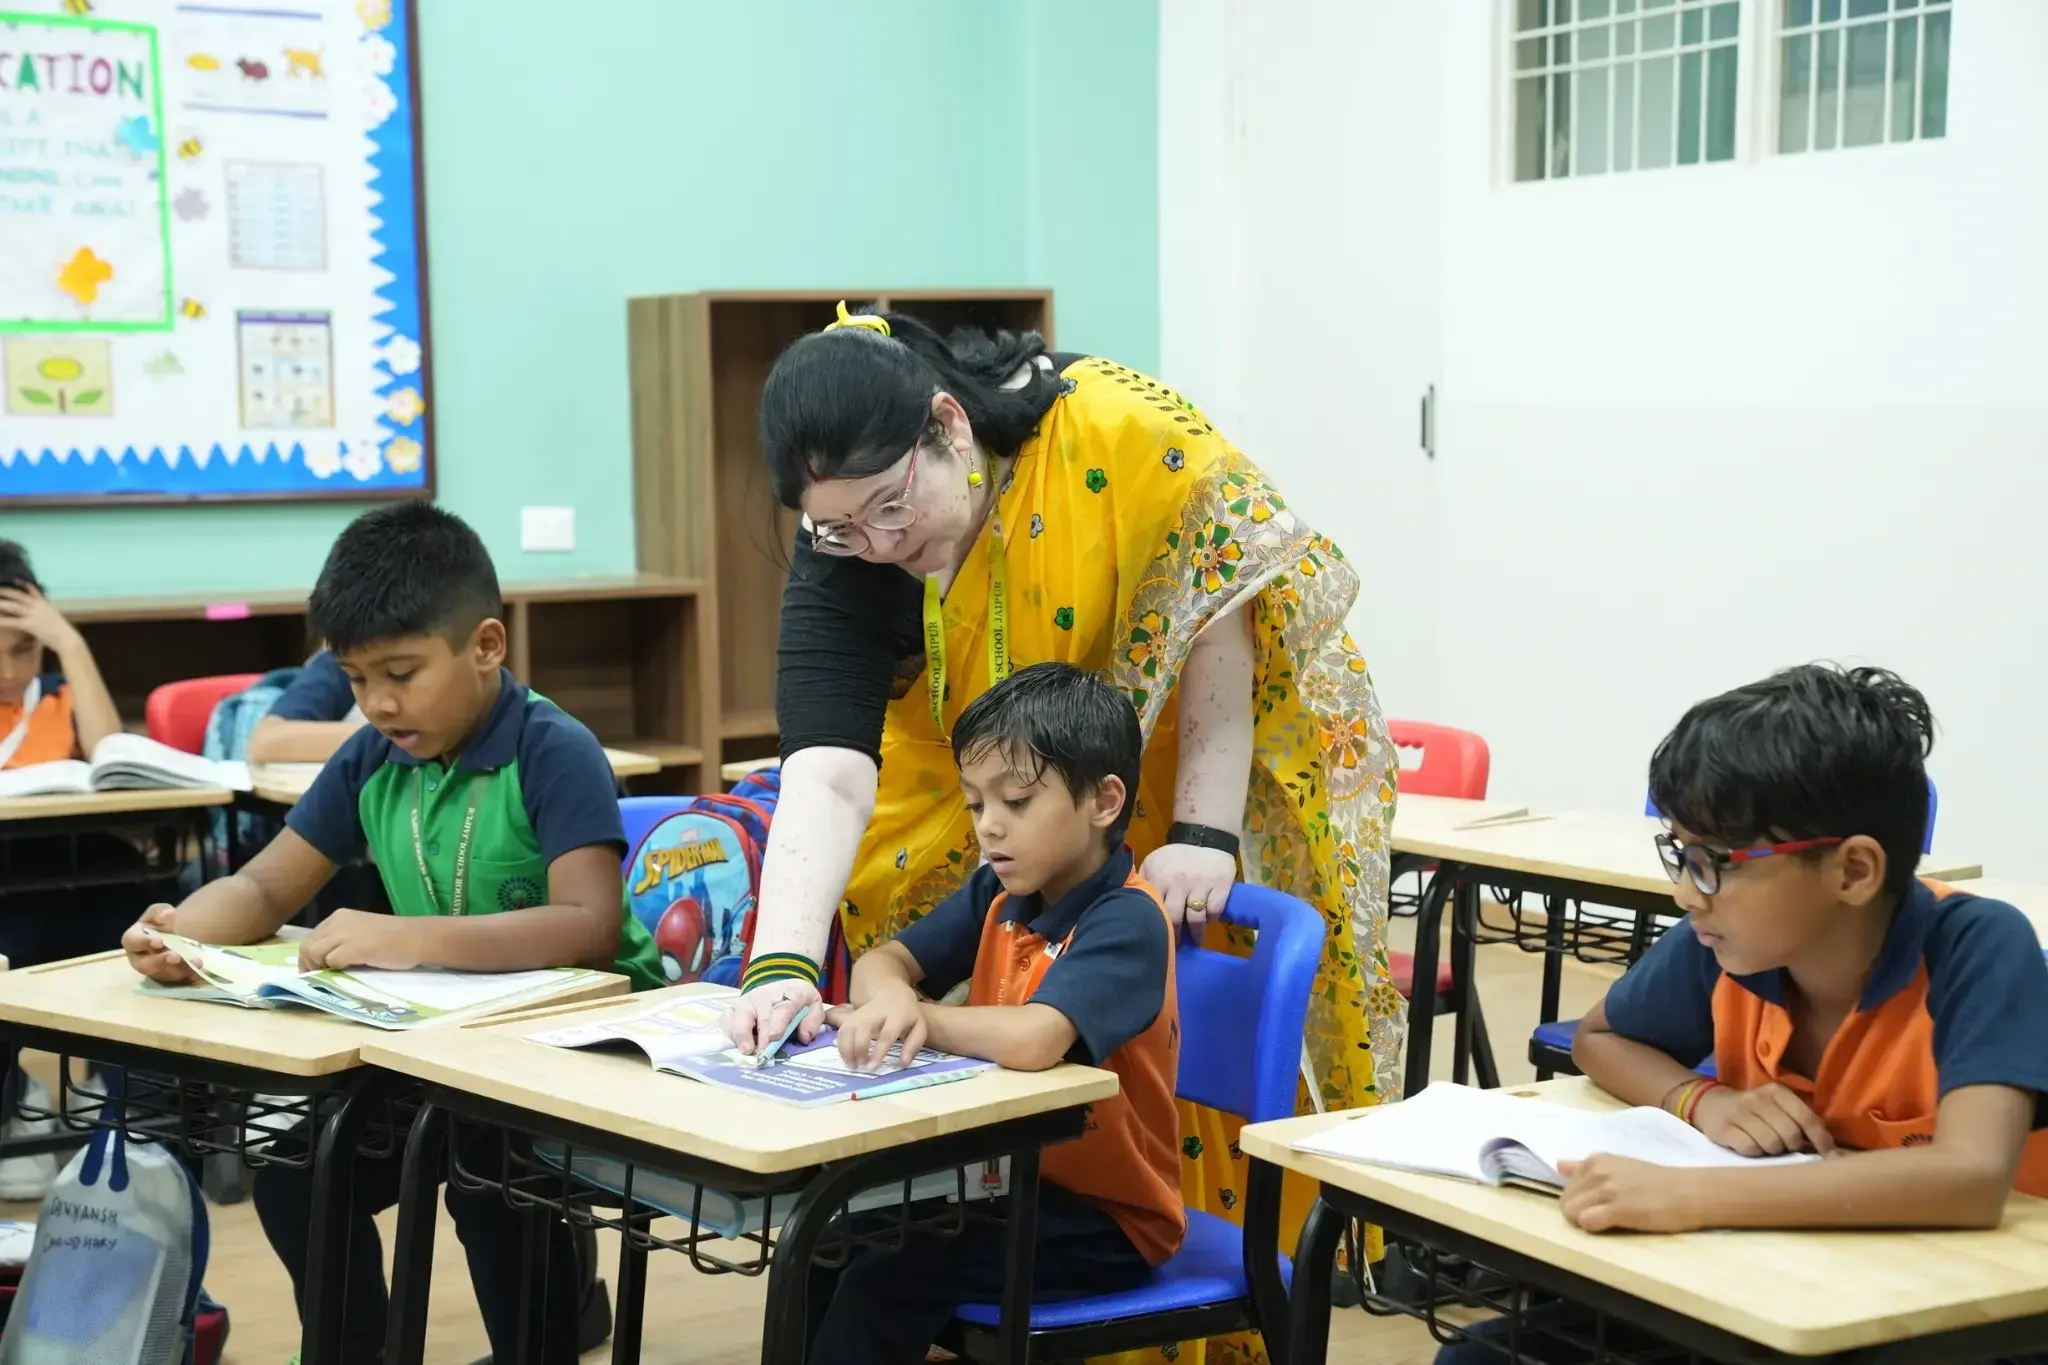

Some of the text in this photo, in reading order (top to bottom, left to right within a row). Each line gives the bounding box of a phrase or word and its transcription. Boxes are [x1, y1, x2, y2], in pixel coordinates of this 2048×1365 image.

[994, 581, 1004, 623] JAIPUR
[929, 621, 940, 662] JAIPUR
[994, 625, 1003, 673] SCHOOL
[932, 664, 942, 713] SCHOOL
[456, 841, 468, 877] SCHOOL
